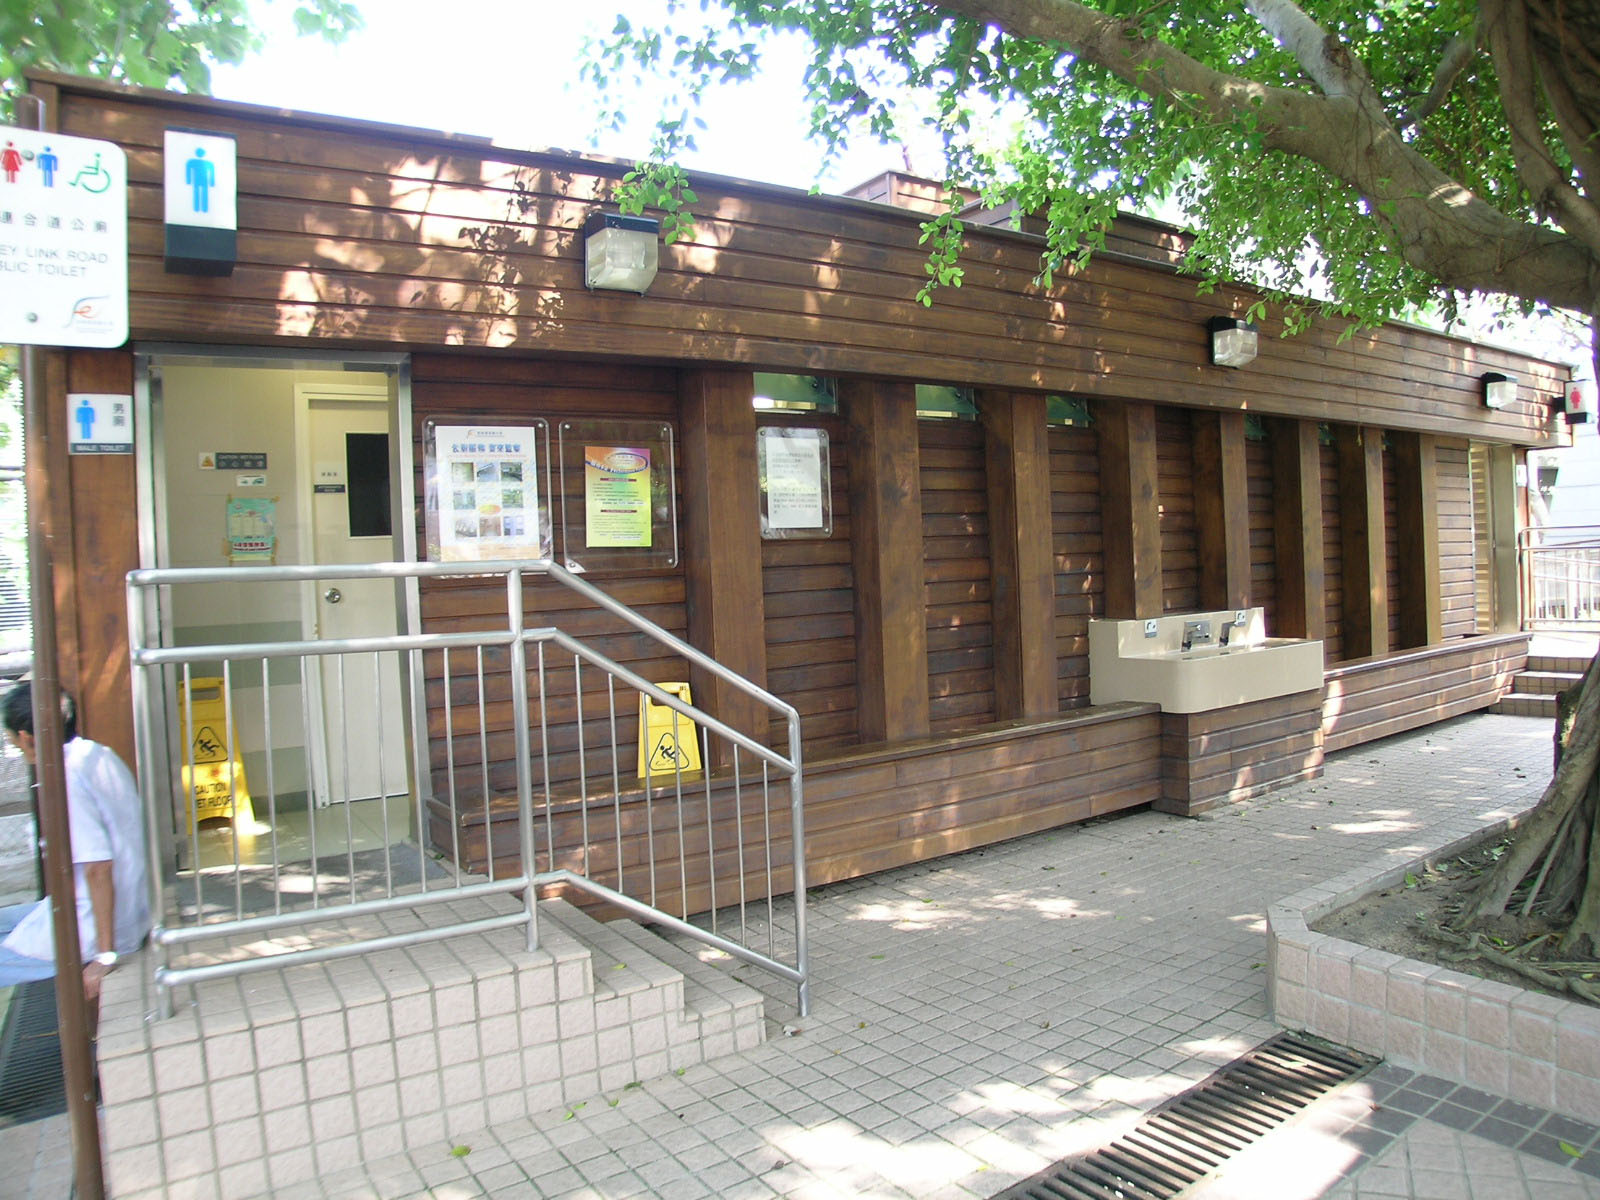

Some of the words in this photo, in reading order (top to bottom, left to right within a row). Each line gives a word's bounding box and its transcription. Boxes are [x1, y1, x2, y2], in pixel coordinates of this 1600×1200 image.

[25, 246, 58, 260] LINK
[66, 249, 108, 264] ROAD
[37, 262, 87, 277] TOILET
[195, 783, 226, 795] CAUTION
